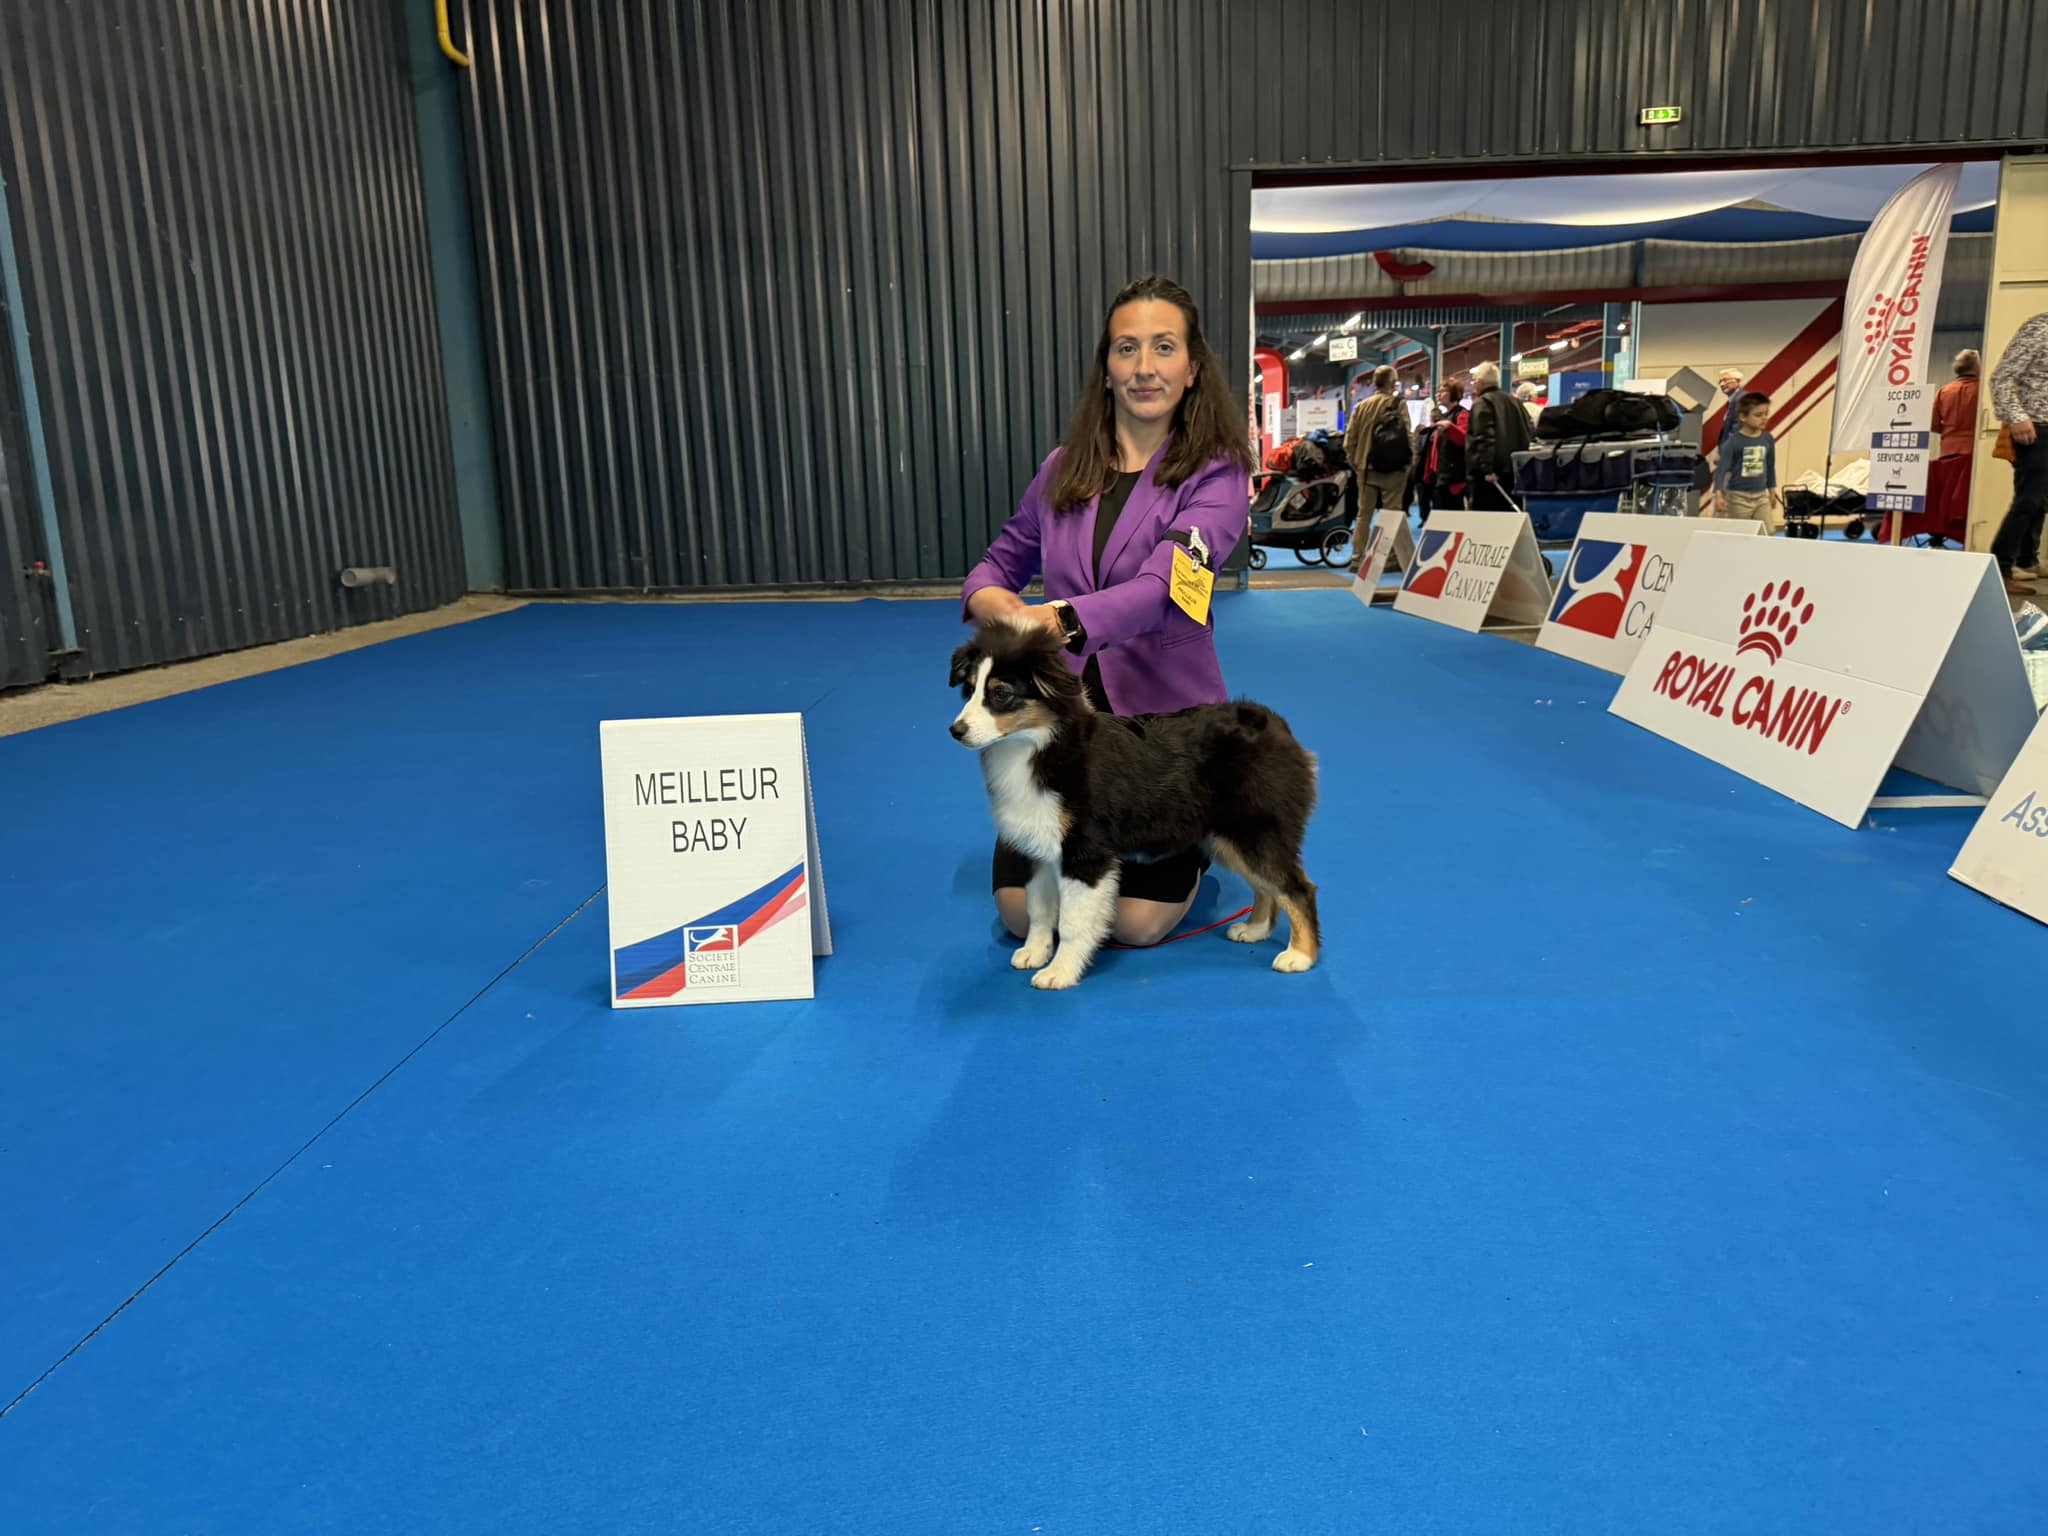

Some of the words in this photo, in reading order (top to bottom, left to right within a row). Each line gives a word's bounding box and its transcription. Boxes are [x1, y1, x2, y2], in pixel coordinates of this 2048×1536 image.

[1888, 322, 1916, 386] OYAL
[1887, 390, 1902, 401] SCC
[1903, 390, 1921, 401] EXPO
[1877, 453, 1903, 463] SERVICE
[1904, 453, 1920, 463] ADN
[1457, 537, 1510, 569] CENTRALE
[1444, 570, 1495, 604] CANINE
[1652, 650, 1736, 718] ROYAL
[635, 767, 780, 806] MEILLEUR
[672, 817, 748, 853] BABY
[688, 962, 737, 974] CENTRALE
[688, 973, 737, 985] CANINE
